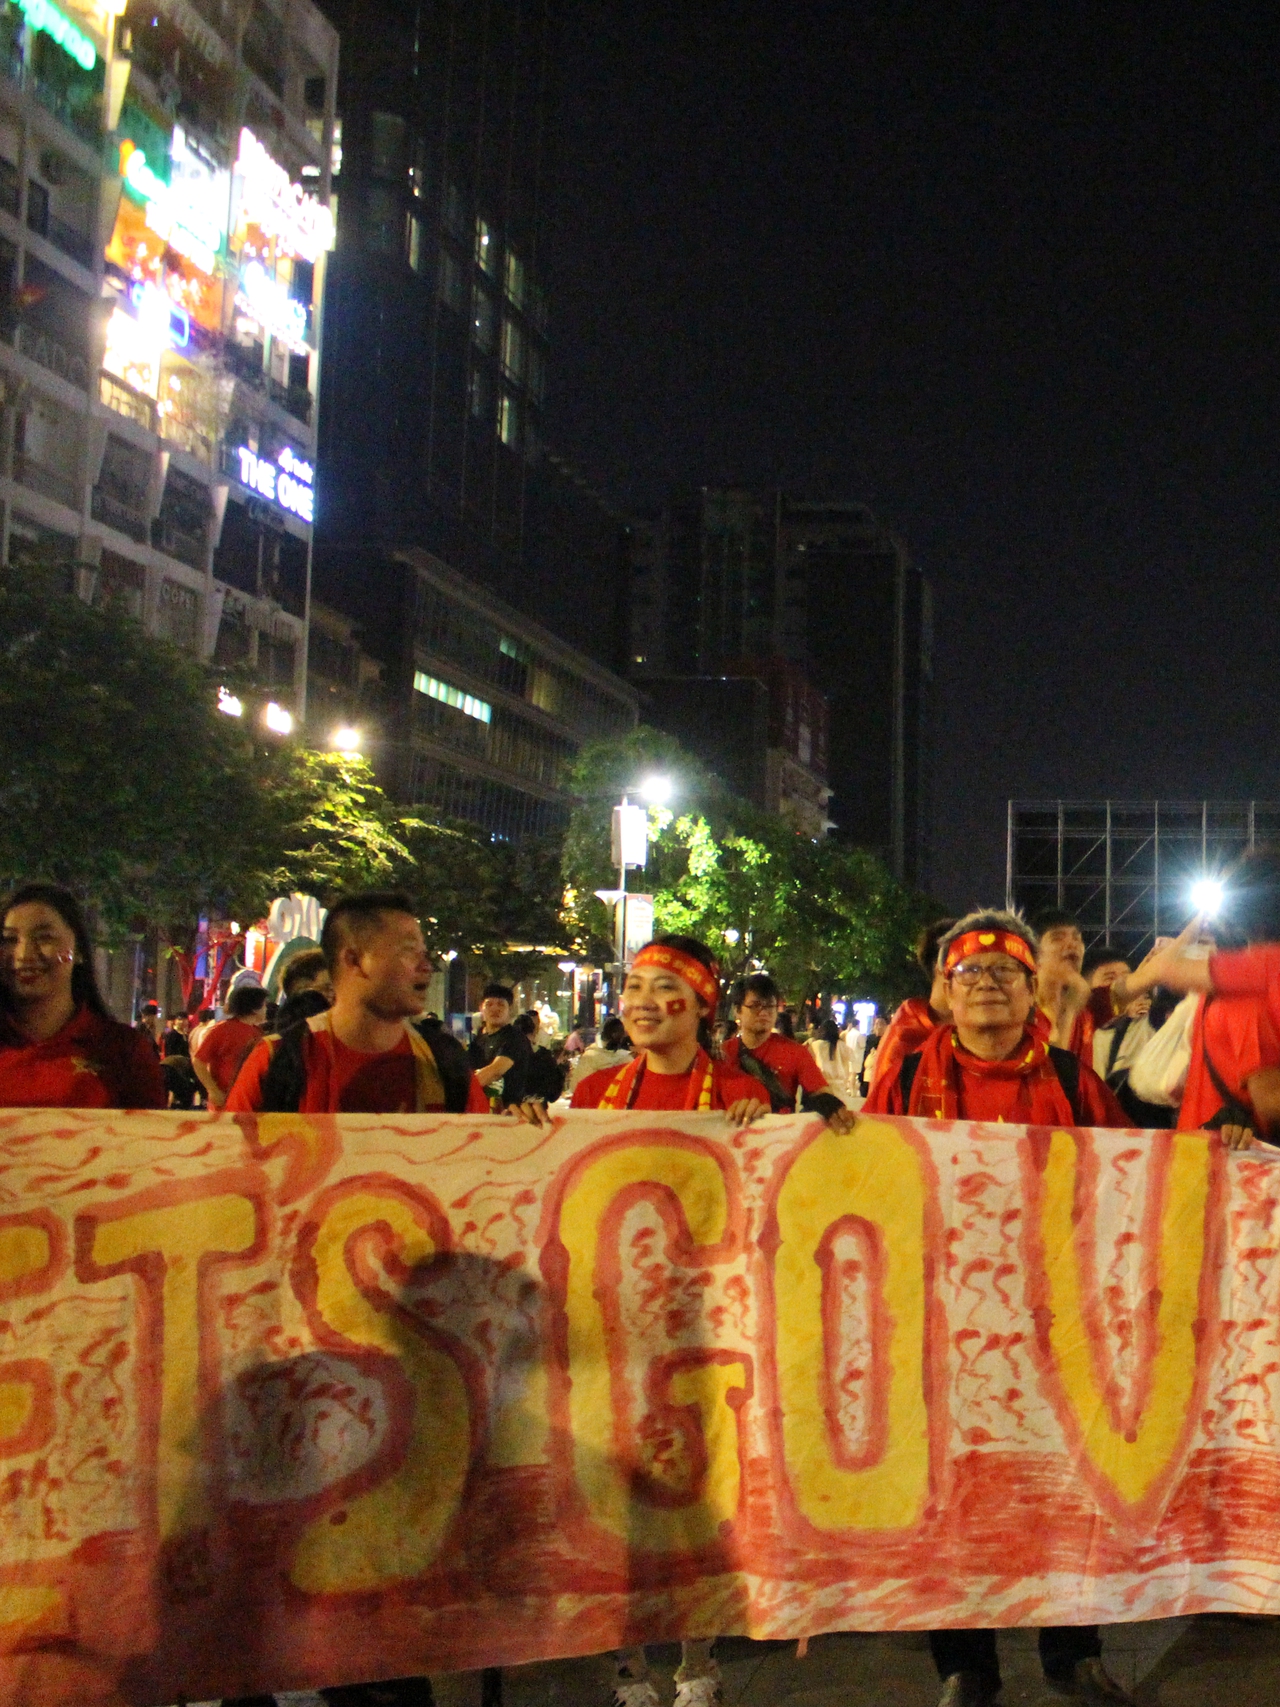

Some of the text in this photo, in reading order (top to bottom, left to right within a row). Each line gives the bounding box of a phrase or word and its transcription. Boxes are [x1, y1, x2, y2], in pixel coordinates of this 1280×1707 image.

[238, 446, 276, 500] THE
[278, 472, 314, 522] ONE
[538, 1114, 946, 1582] GO
